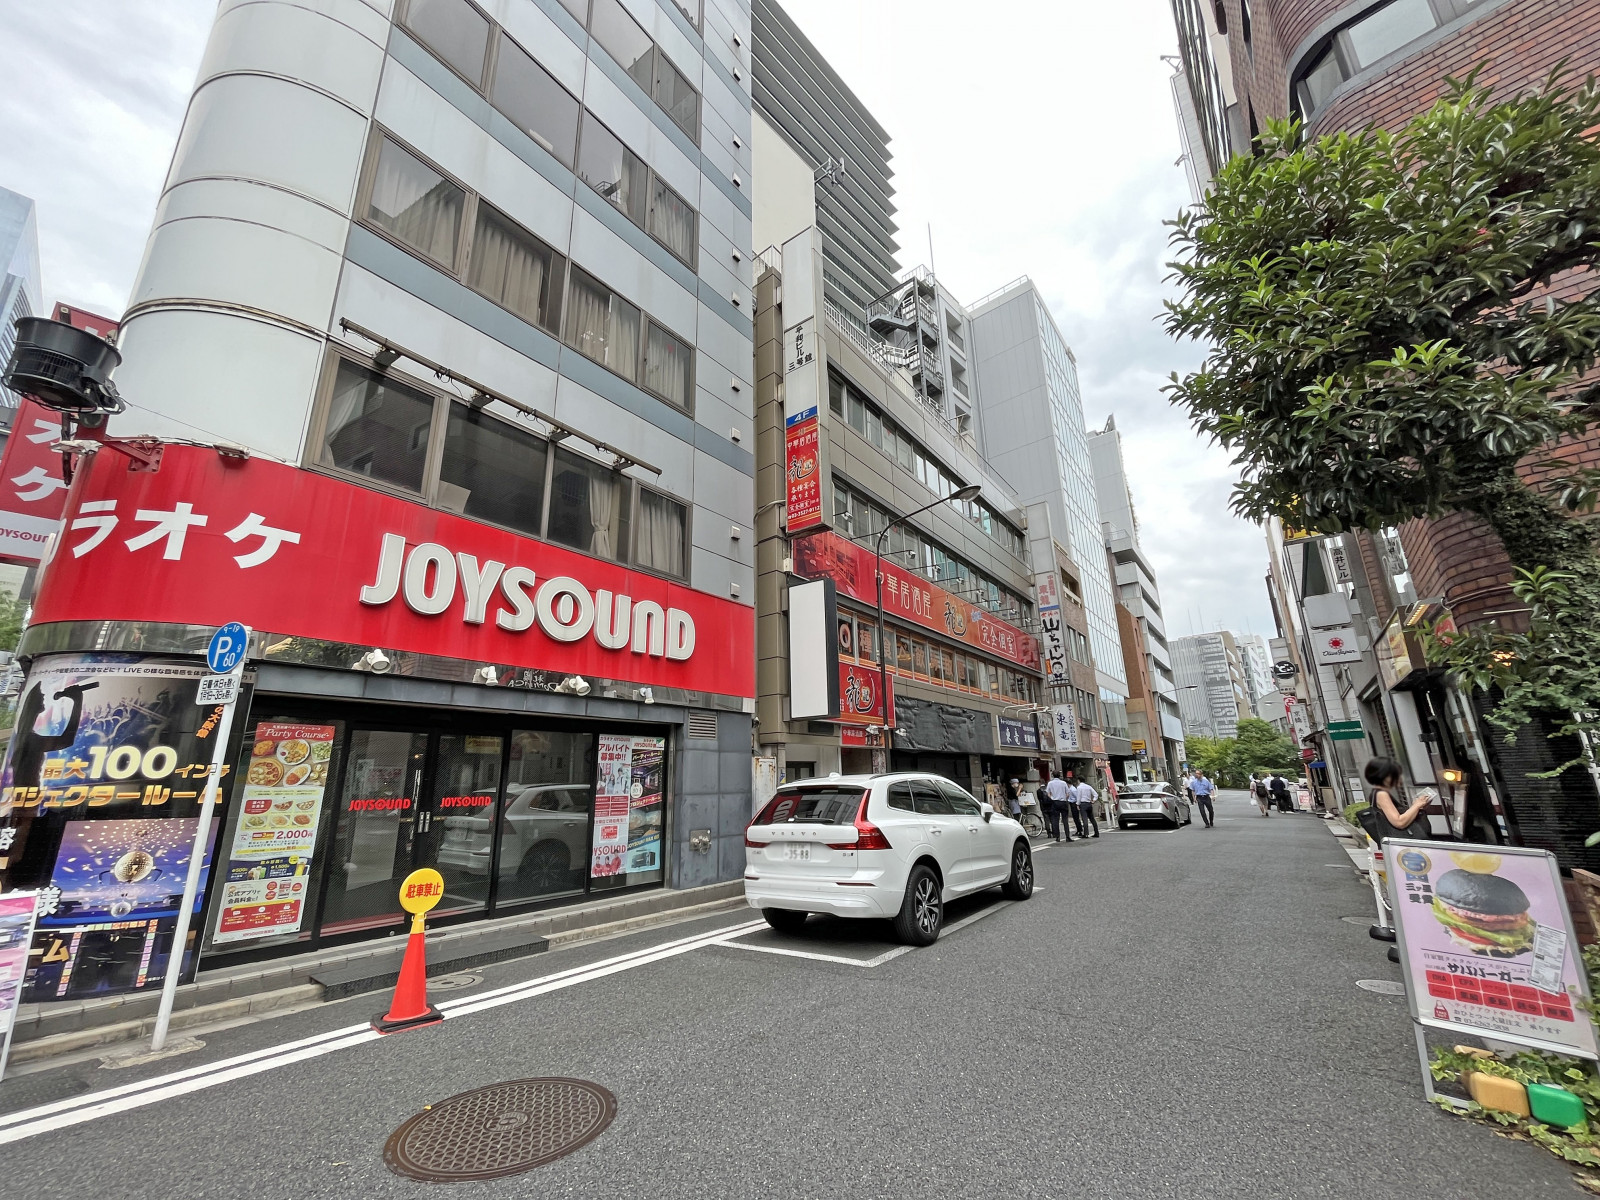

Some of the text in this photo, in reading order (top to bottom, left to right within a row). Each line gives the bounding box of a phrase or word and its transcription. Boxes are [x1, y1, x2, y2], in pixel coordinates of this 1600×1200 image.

[793, 408, 810, 422] 4F
[48, 499, 301, 569] ラオケ
[1333, 547, 1349, 579] 高井ビル
[359, 532, 697, 661] JOYSOUND
[223, 624, 240, 634] 9-19
[1042, 617, 1065, 661] 山ちゃん
[213, 636, 233, 668] P
[222, 652, 236, 667] 60
[123, 667, 143, 675] LIVE
[264, 728, 327, 740] Party Course
[598, 743, 630, 752] アルバイト
[348, 797, 412, 812] JOYSOUND
[440, 796, 493, 808] JOYSOUND
[276, 829, 314, 840] 2,000円
[405, 882, 442, 899] 駐車禁止
